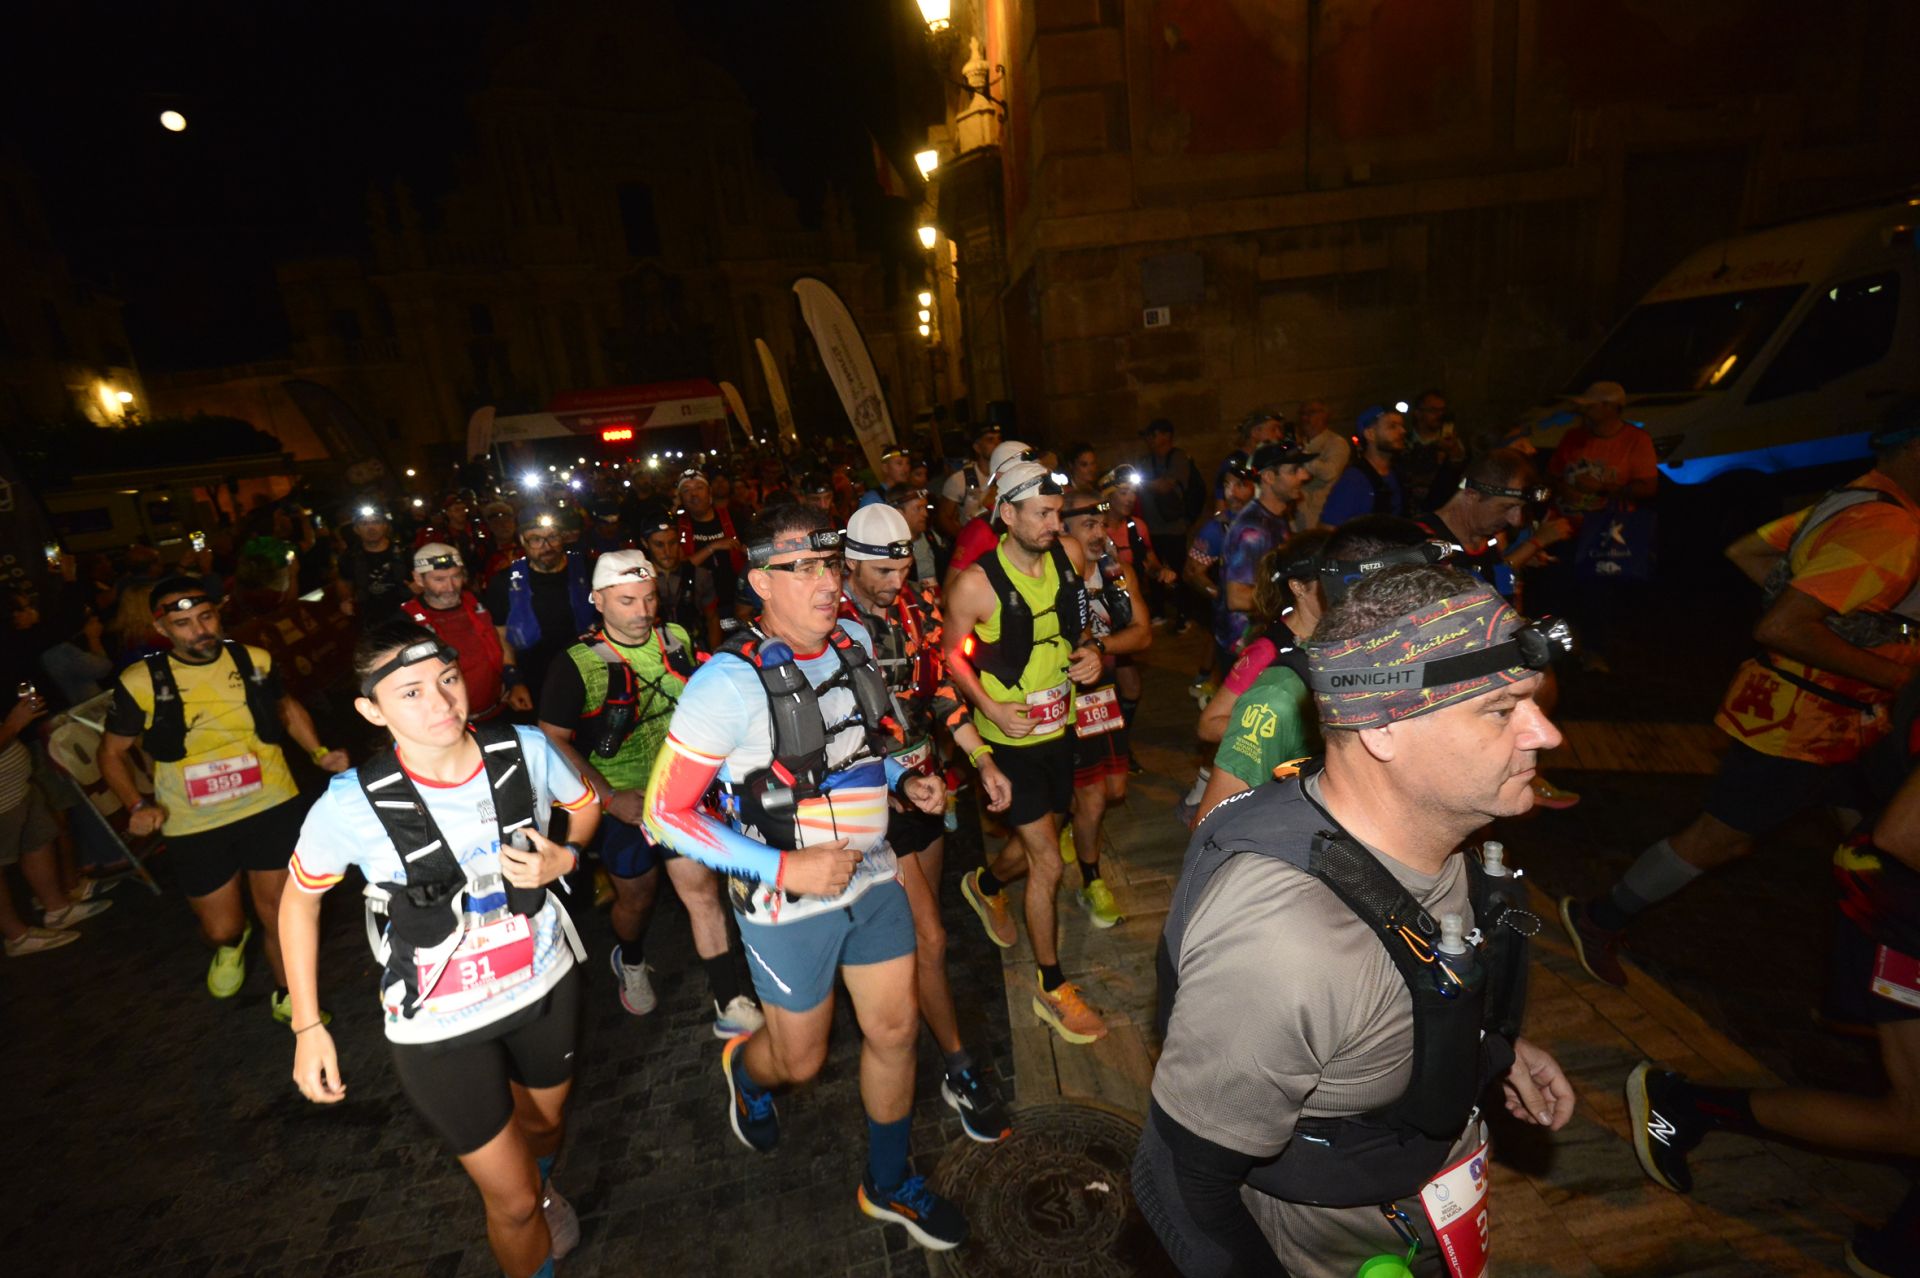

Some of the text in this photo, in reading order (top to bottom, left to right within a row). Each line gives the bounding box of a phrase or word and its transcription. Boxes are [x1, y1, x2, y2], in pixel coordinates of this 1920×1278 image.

[1330, 670, 1415, 688] ONNIGHT
[1042, 702, 1066, 721] 169
[1083, 706, 1109, 723] 168
[205, 772, 244, 793] 359
[458, 955, 496, 985] 31
